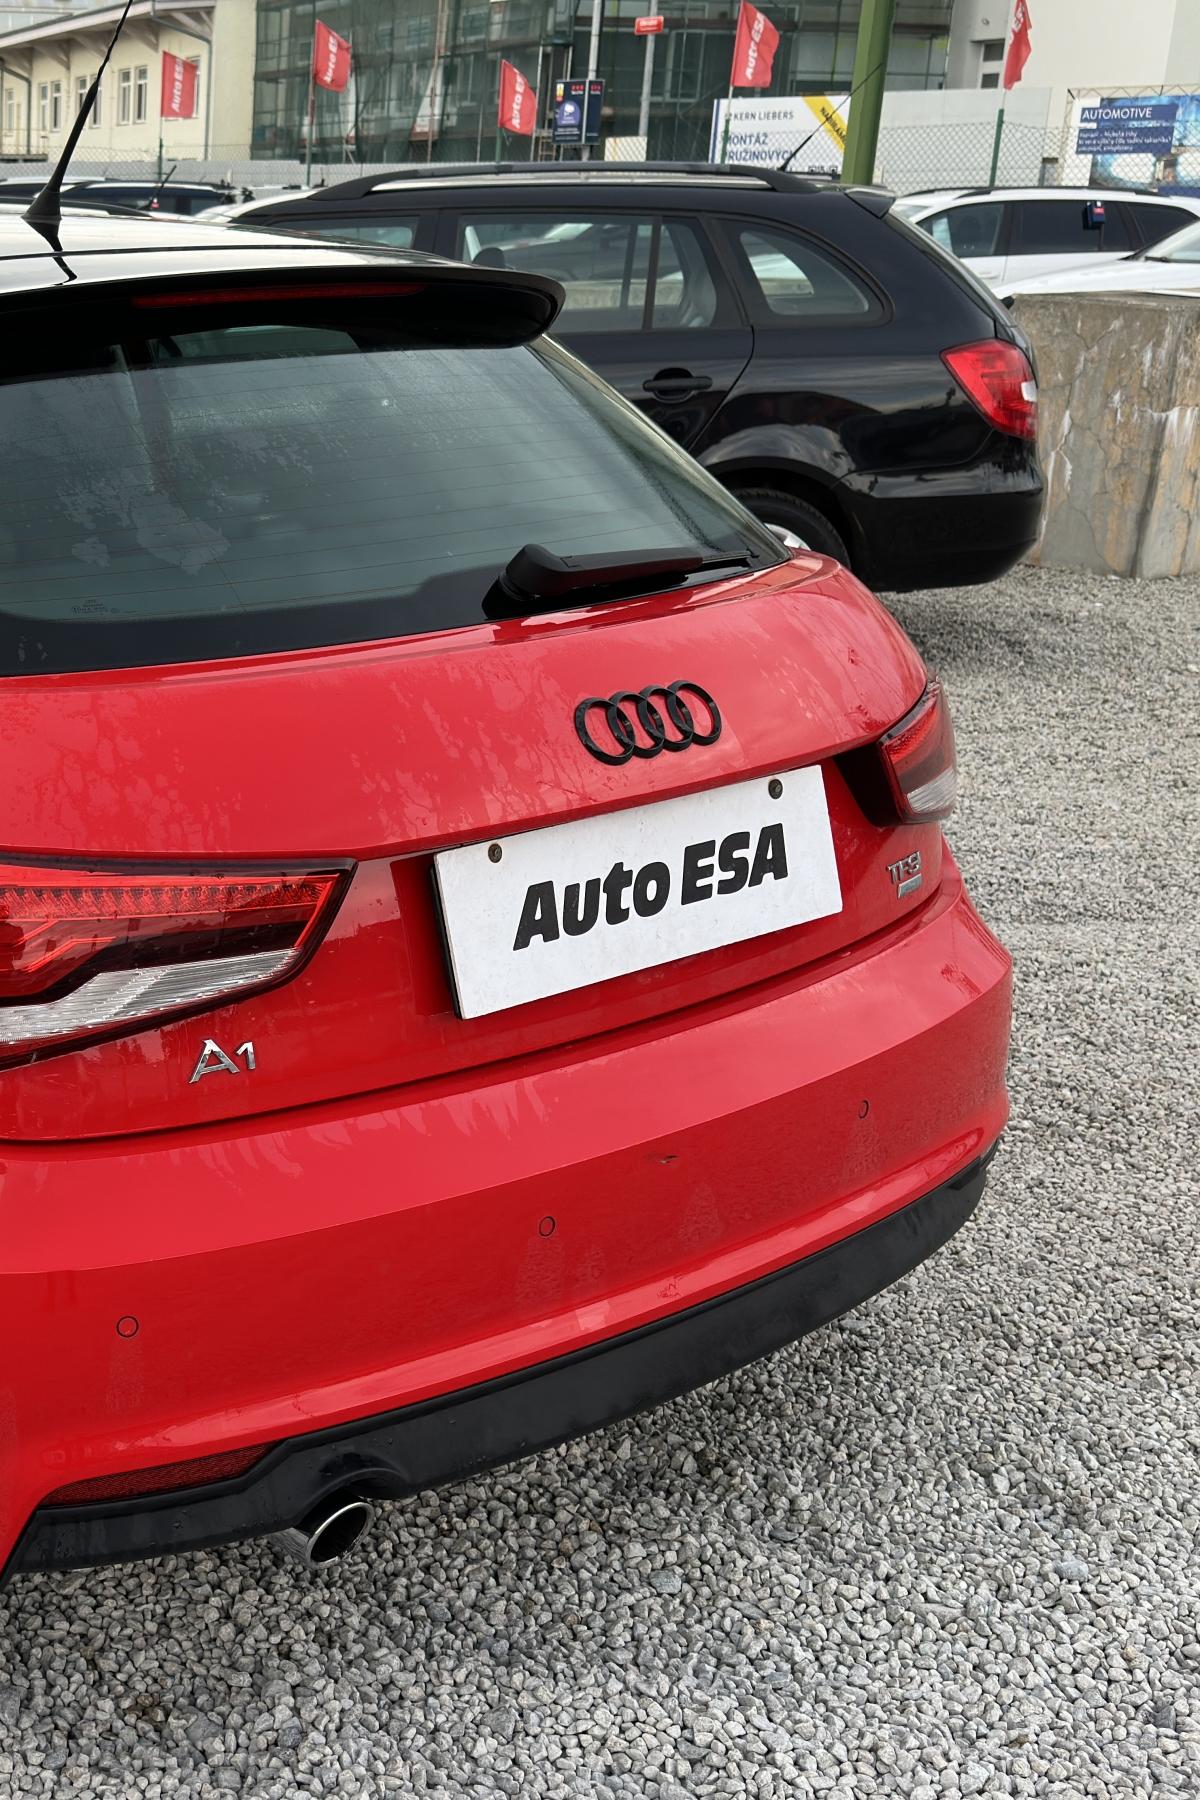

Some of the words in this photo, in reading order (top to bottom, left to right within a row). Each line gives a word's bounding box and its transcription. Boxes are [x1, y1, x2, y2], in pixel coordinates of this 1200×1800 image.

[511, 94, 523, 130] Auto
[734, 111, 756, 121] KERN
[758, 110, 794, 121] LIEBERS
[1081, 106, 1153, 120] AUTOMOTIVE
[513, 861, 671, 952] Auto
[681, 823, 789, 906] ESA
[188, 1038, 257, 1084] A1
